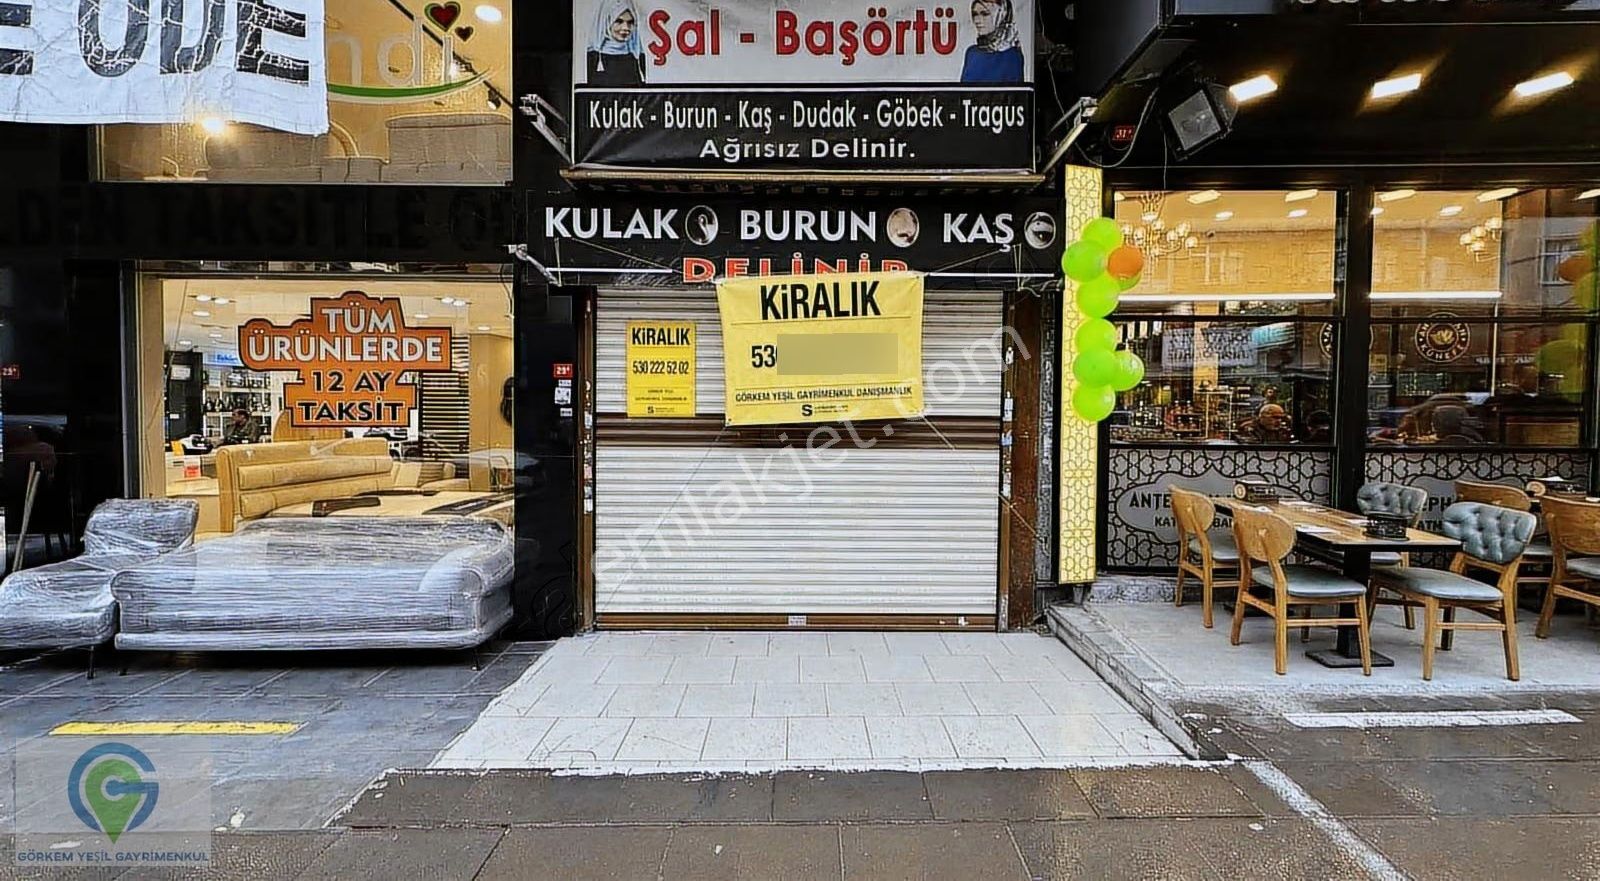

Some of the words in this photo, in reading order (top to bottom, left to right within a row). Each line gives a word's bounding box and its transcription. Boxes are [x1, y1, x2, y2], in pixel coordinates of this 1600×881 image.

[647, 8, 721, 66] Şal
[775, 6, 958, 66] Başörtü
[326, 17, 454, 87] ndi
[589, 99, 644, 128] Kulak
[664, 100, 718, 128] Burun
[738, 100, 772, 134] Kaş
[793, 99, 857, 128] Dudak
[876, 98, 944, 128] Göbek
[962, 99, 1025, 134] Tragus
[699, 137, 801, 163] Ağrısız
[811, 137, 916, 158] Delinir.
[545, 207, 680, 239] KULAK
[740, 209, 877, 242] BURUN
[943, 213, 1016, 253] KAŞ
[321, 301, 396, 334] TÜM
[248, 329, 443, 362] ÜRÜNLERDE
[751, 344, 778, 369] 53
[312, 371, 345, 393] 12
[353, 371, 393, 393] AY
[633, 360, 649, 375] 530
[649, 360, 666, 375] 222
[667, 360, 678, 375] 52
[679, 360, 690, 375] 02
[297, 396, 404, 421] TAKSİT
[735, 392, 770, 403] GÖRKEM
